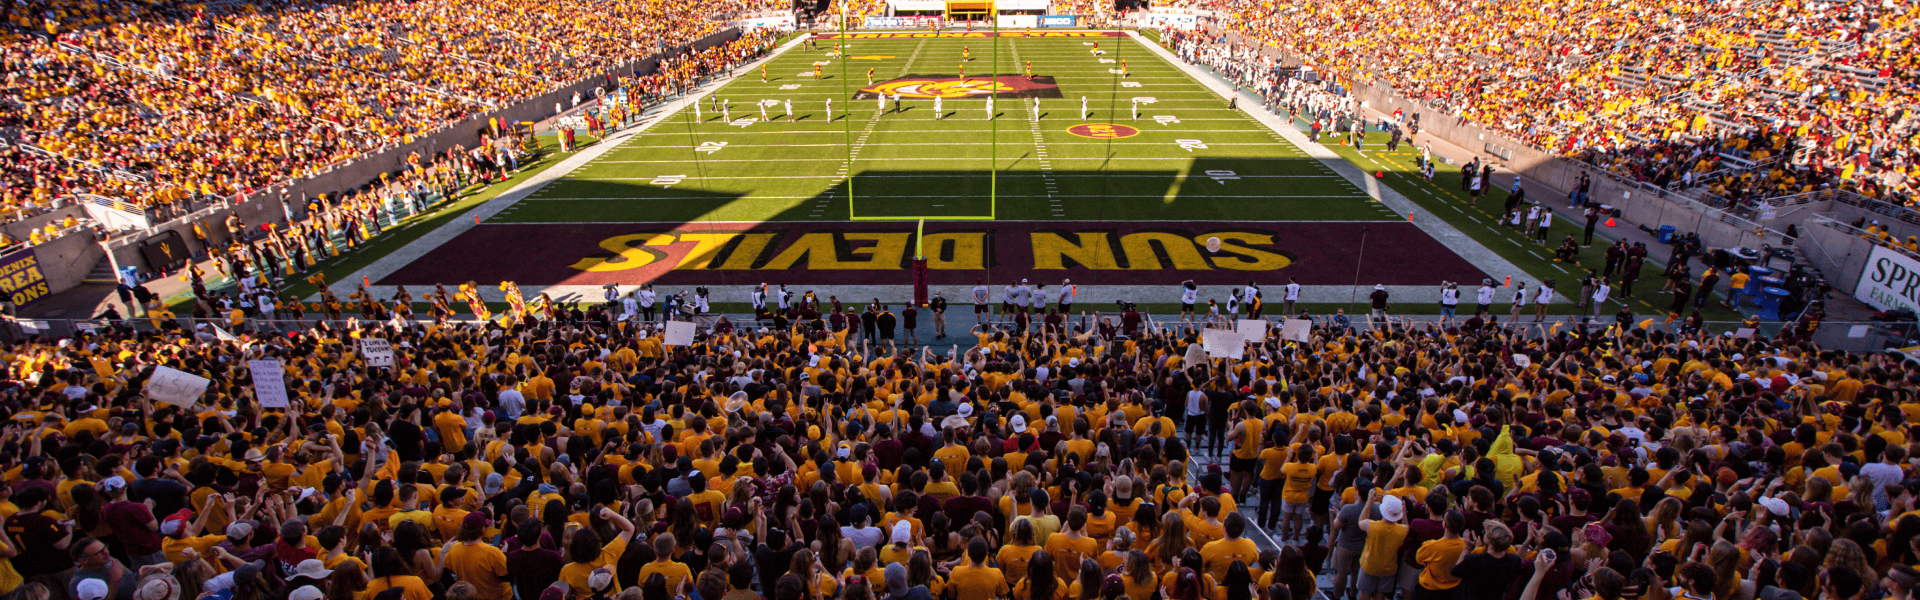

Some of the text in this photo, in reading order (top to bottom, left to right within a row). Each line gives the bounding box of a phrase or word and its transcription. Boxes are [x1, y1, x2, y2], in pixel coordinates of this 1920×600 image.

[694, 141, 728, 152] 20
[1174, 138, 1208, 149] 20
[649, 174, 687, 185] 10
[1204, 169, 1241, 180] 10
[567, 230, 1292, 272] SUN DEVILS
[1871, 257, 1920, 306] SPR
[13, 281, 49, 306] ONS
[150, 374, 201, 399] ASU
